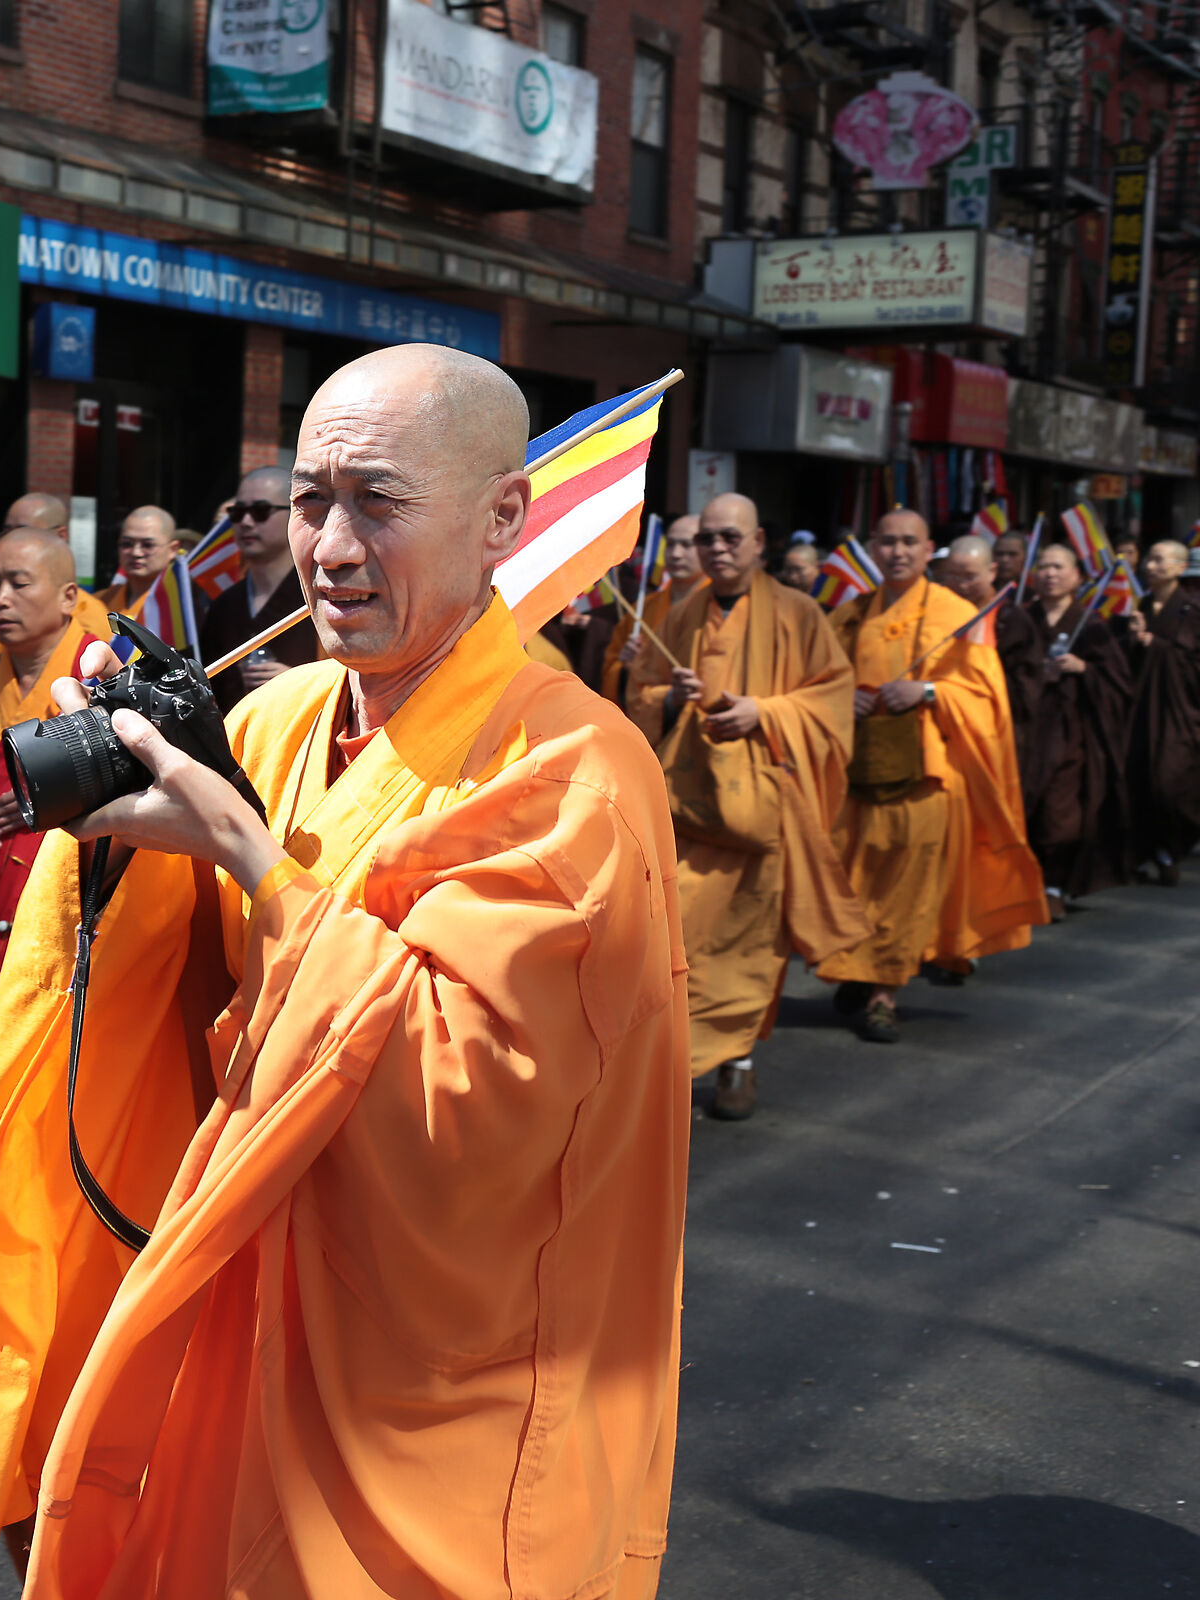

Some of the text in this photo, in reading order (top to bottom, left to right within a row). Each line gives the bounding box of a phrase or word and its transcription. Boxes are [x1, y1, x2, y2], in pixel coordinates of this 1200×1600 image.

[243, 39, 280, 55] NYC
[18, 234, 324, 318] NATOWN COMMUNITY CENTER
[763, 281, 825, 305] LOBSTER
[829, 279, 867, 303] BOAT
[871, 275, 967, 300] RESTAURANT
